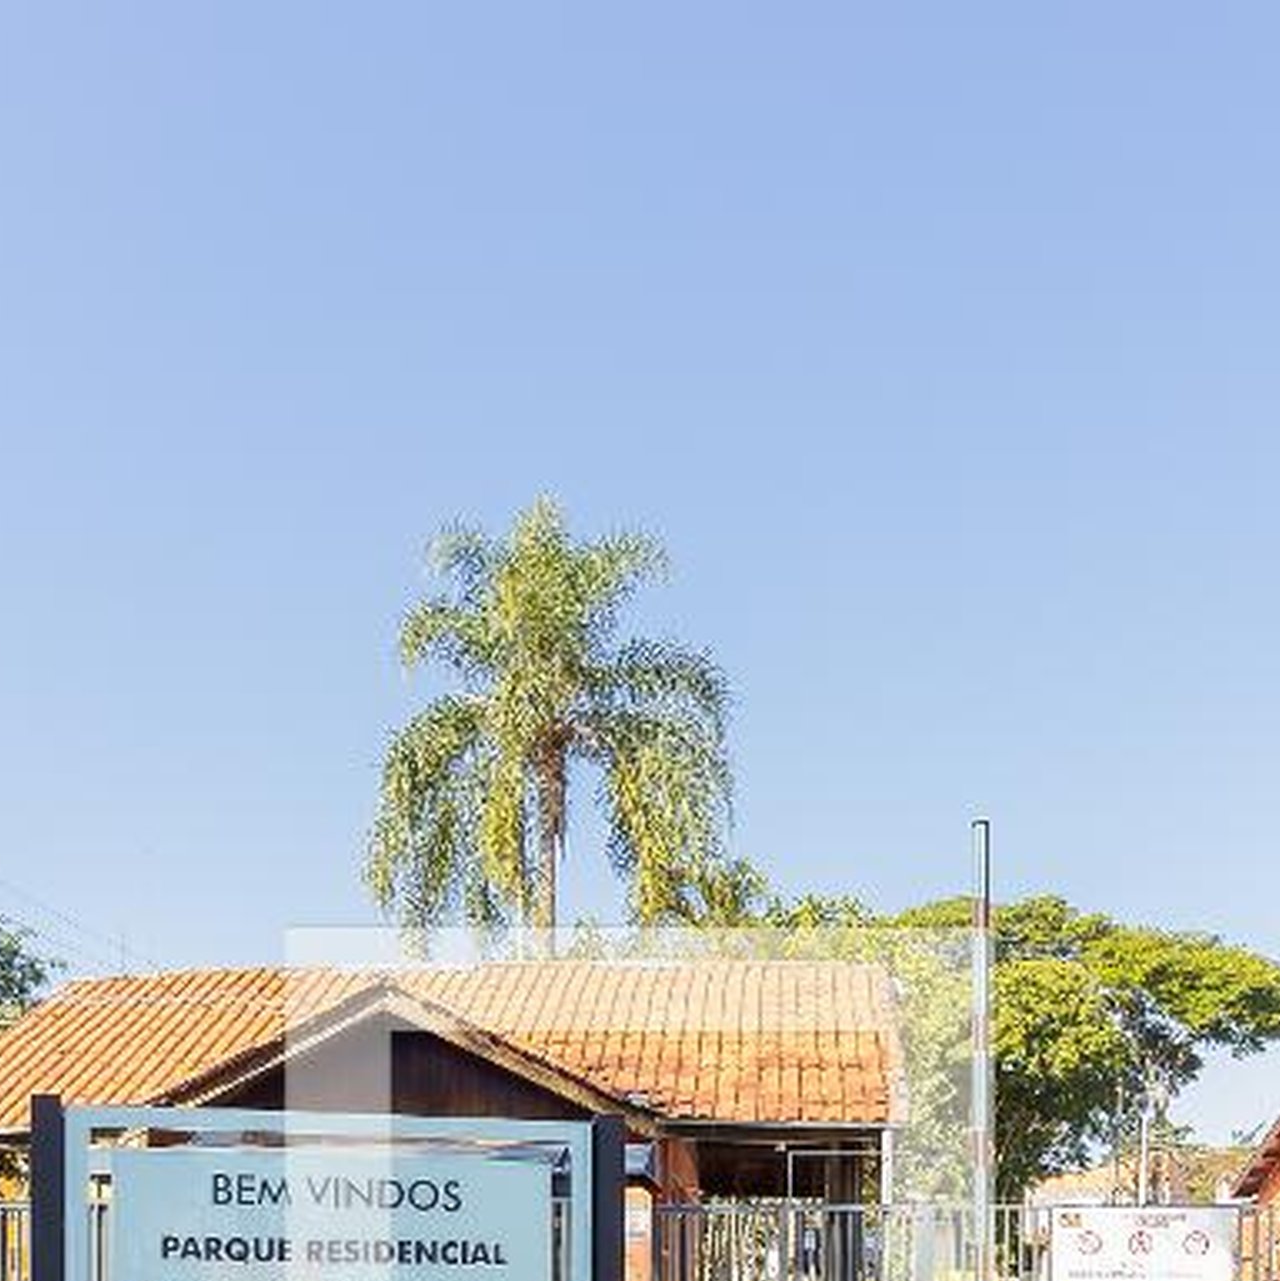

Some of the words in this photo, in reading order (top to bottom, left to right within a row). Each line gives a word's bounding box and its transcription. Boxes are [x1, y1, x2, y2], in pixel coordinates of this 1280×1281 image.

[212, 1174, 290, 1206] BEM
[307, 1178, 463, 1212] VINDOS
[161, 1235, 293, 1264] PARQUE
[307, 1240, 508, 1266] RESIDENCIAL
